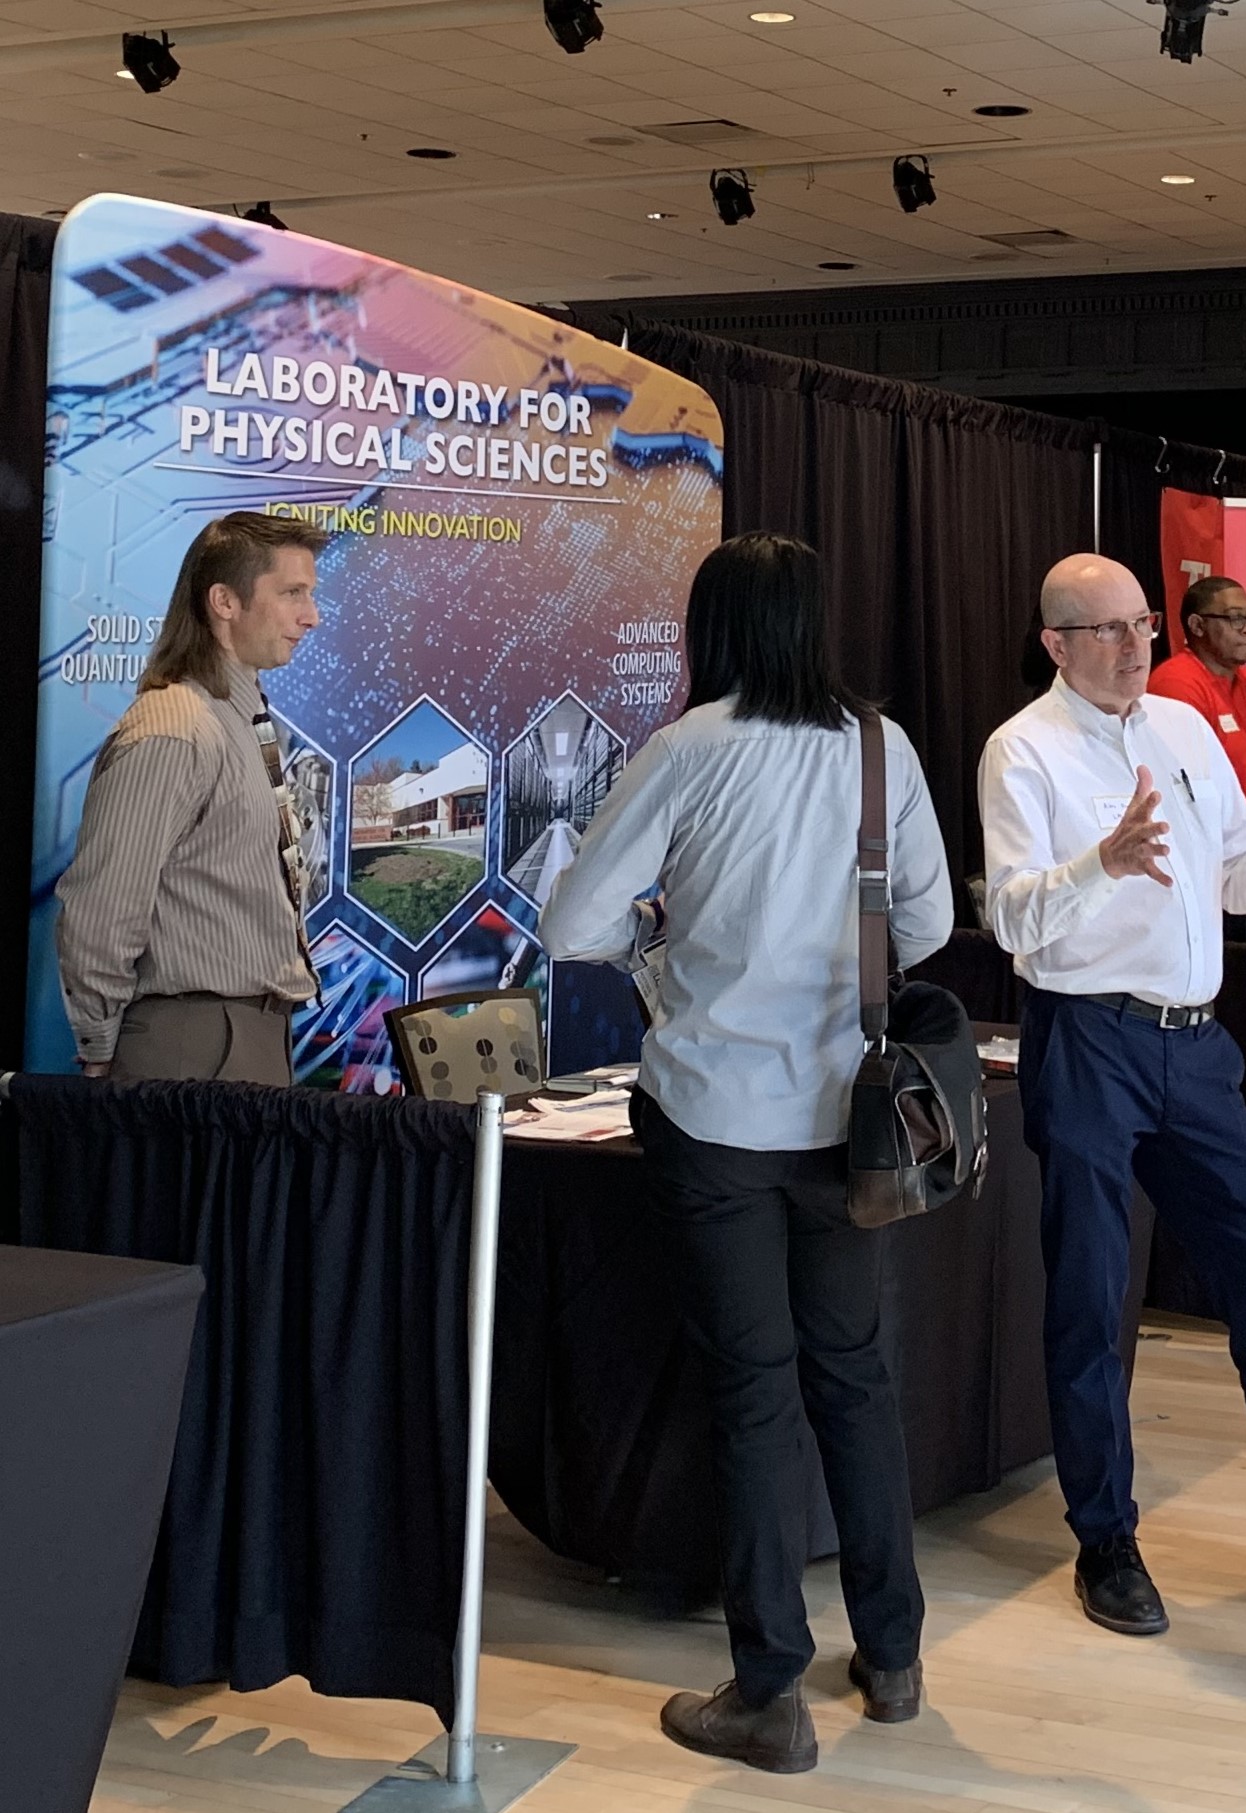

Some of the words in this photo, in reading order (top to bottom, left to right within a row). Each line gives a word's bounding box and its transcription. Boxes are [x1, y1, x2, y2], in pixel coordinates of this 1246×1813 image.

[206, 347, 506, 425] LABORATORY
[519, 388, 593, 435] FOR
[179, 405, 412, 471] PHYSICAL
[425, 432, 608, 488] SCIENCES
[383, 509, 522, 542] INNOVATION
[87, 613, 141, 644] SOLID
[617, 620, 680, 645] ADVANCED
[612, 650, 682, 676] COMPUTING
[620, 681, 672, 706] SYSTEMS
